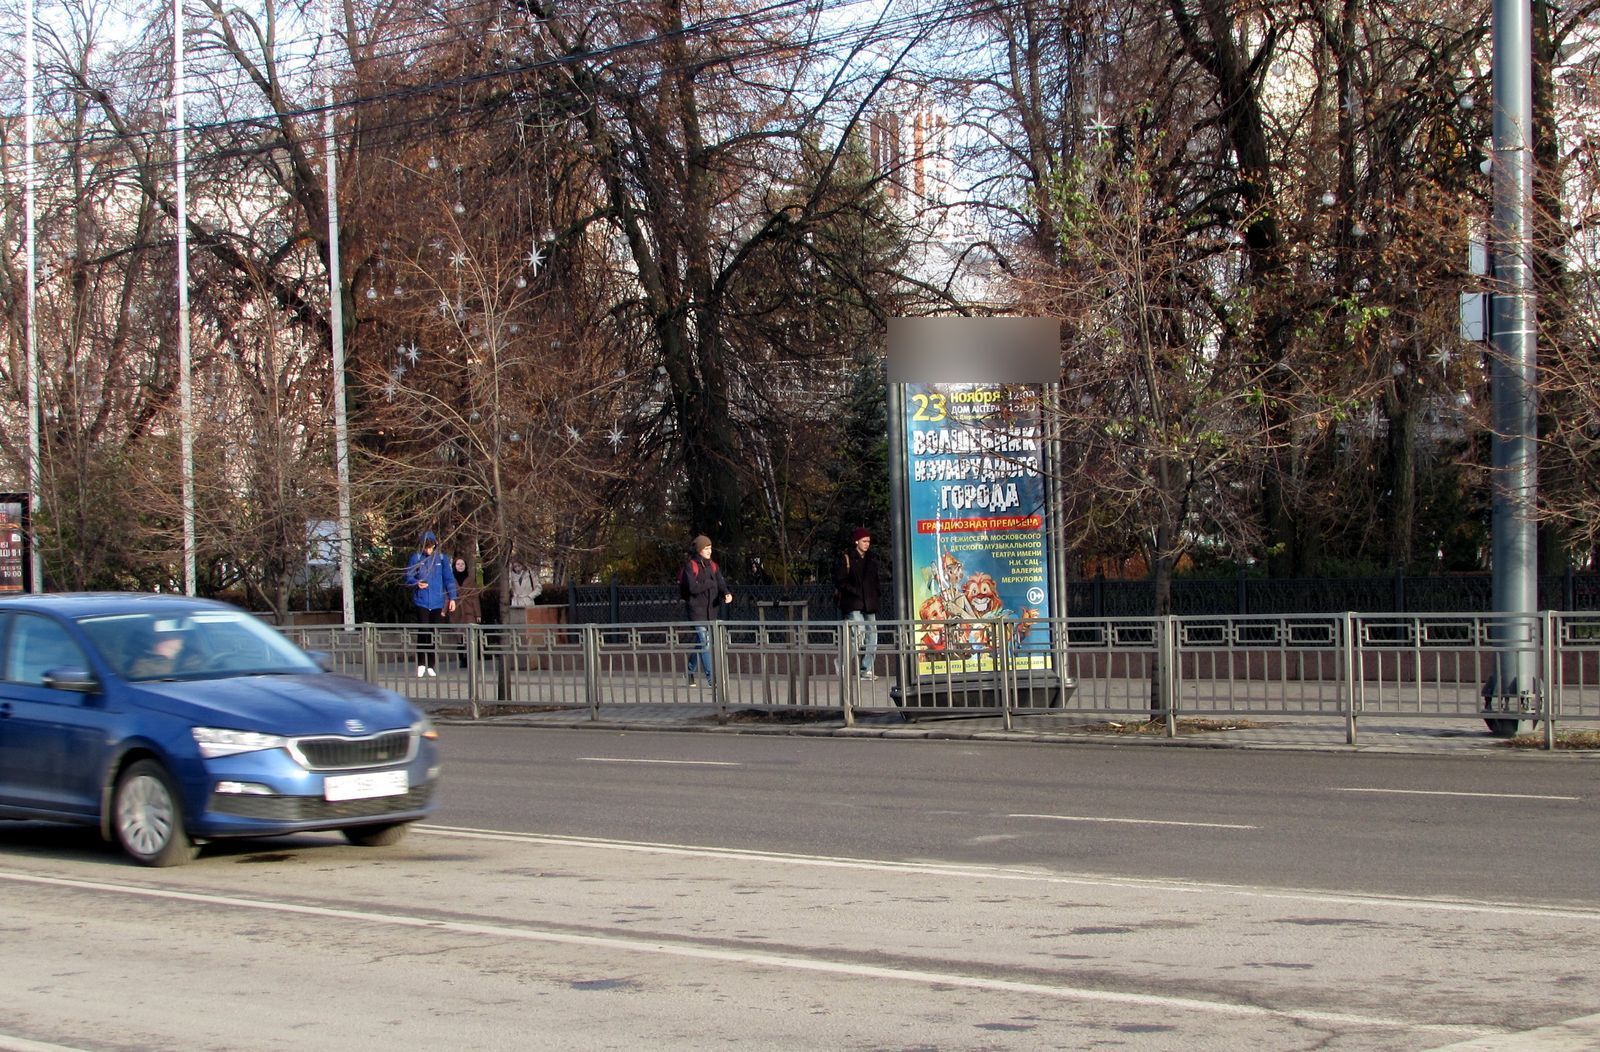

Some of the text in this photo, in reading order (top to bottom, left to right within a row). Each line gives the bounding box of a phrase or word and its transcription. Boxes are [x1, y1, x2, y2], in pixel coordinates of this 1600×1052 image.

[950, 388, 1001, 405] ноября
[912, 393, 947, 422] 23
[951, 405, 970, 414] ДОМ
[971, 404, 1001, 414] АКТЕРА
[912, 427, 1037, 455] ВОЛШЕБНИК
[914, 456, 1038, 483] ИЗУМРУДНОГО
[941, 483, 1020, 512] ГОРОДА
[922, 518, 1039, 531] ГРАНДИОЗНАЯ ПРЕМЬЕРА
[990, 533, 1041, 541] МОСКОВСКОГО
[950, 542, 1041, 552] ДЕТСКОГО МУЗЫКАЛЬНОГО
[1001, 575, 1043, 583] МЕРКУЛОВА
